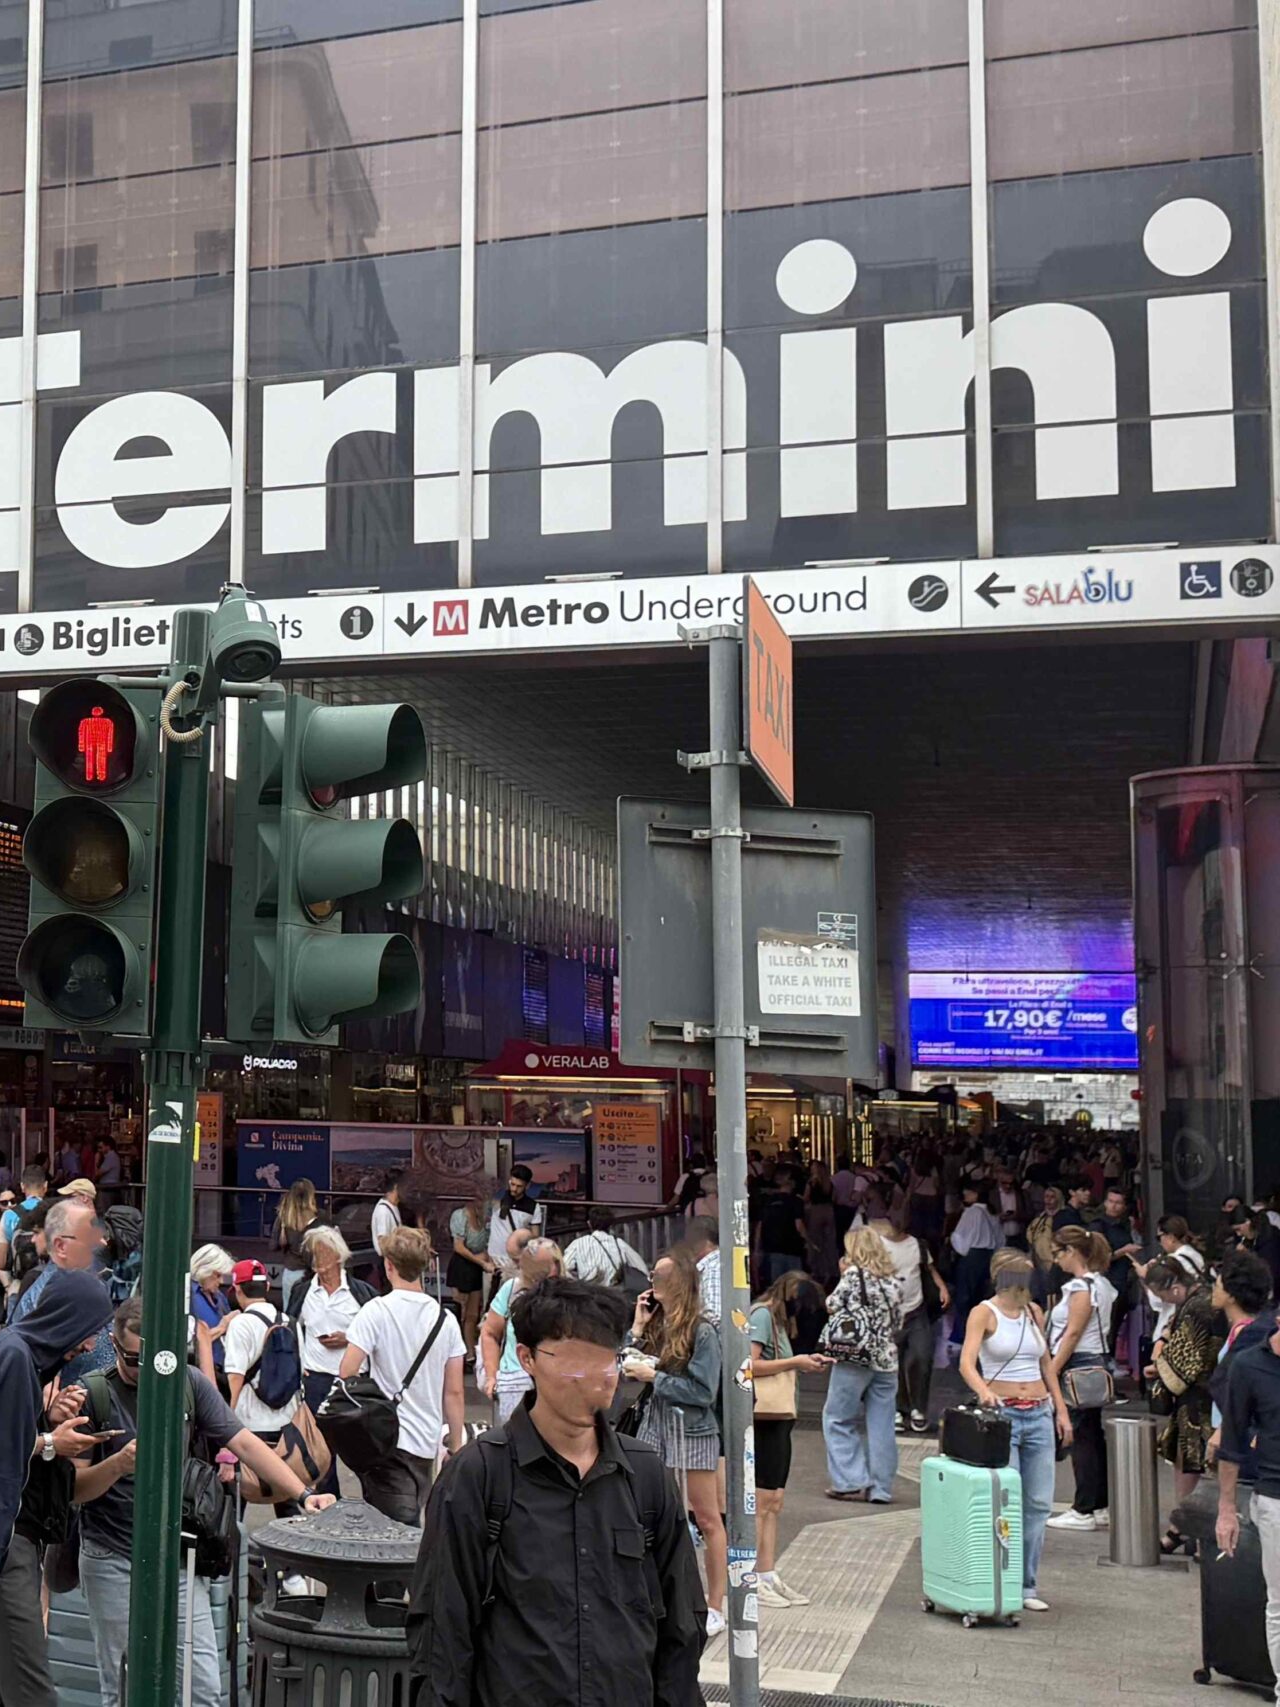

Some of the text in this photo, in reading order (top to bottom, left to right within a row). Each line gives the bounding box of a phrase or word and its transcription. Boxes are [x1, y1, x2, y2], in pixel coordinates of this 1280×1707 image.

[479, 599, 609, 629] Metro
[621, 576, 868, 624] Underound
[53, 617, 170, 656] Bigliet
[753, 629, 790, 756] TAXI
[769, 956, 848, 969] ILLEGAL TAXI
[767, 975, 852, 988] TAKE A WHITE
[768, 995, 852, 1008] OFFICIAL TAXI
[984, 1009, 1063, 1030] 17,90€
[253, 1057, 298, 1070] PIQUADRO
[541, 1055, 610, 1069] VERALAB
[272, 1140, 303, 1152] Divina
